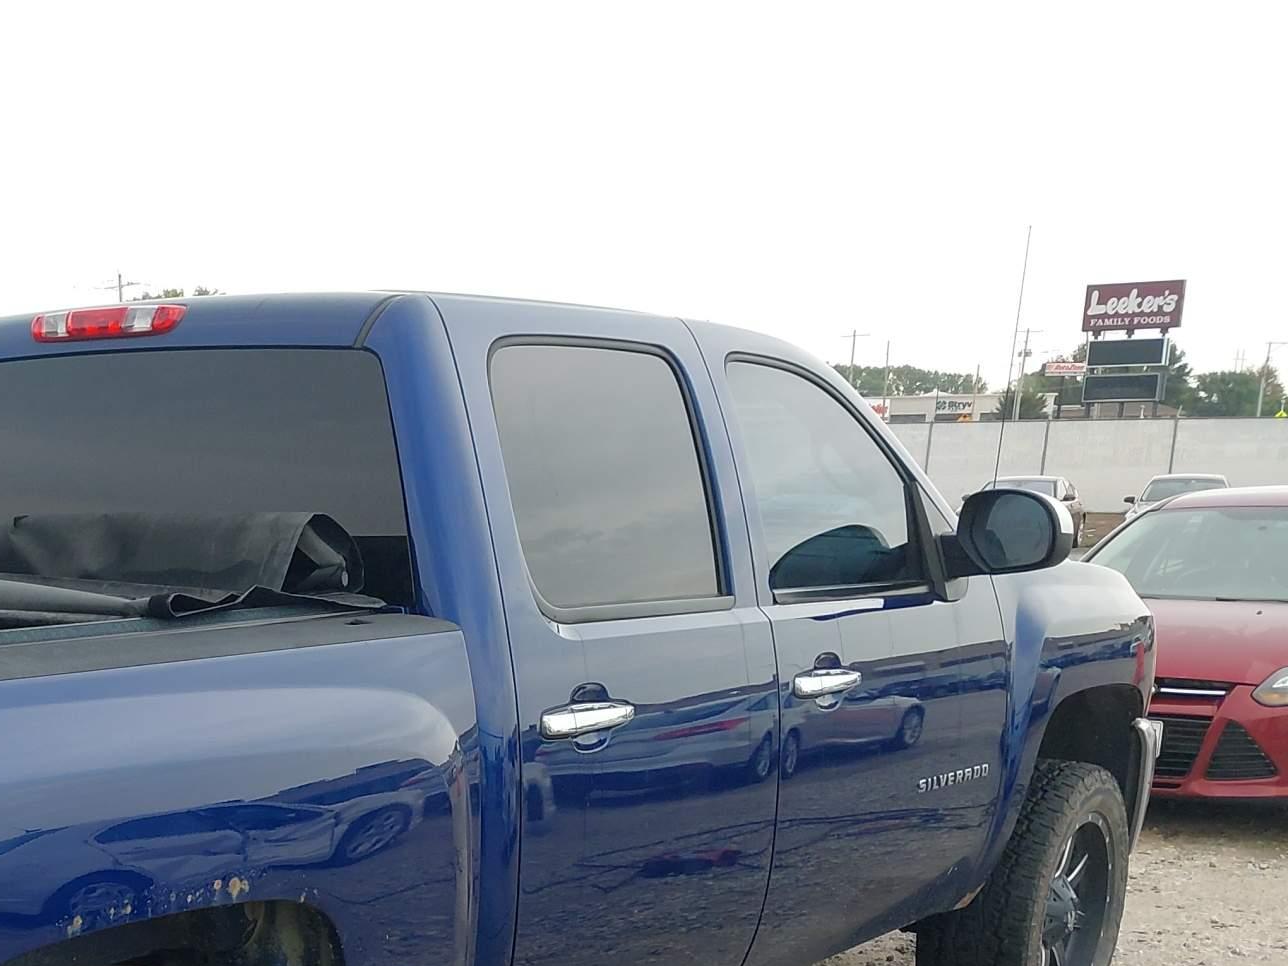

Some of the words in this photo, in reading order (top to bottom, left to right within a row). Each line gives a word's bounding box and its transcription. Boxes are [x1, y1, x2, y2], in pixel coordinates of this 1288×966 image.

[1087, 288, 1178, 315] Leeker's
[1090, 318, 1131, 326] FAMILY
[1133, 316, 1170, 325] FOODS
[918, 763, 989, 793] SILVERADO
